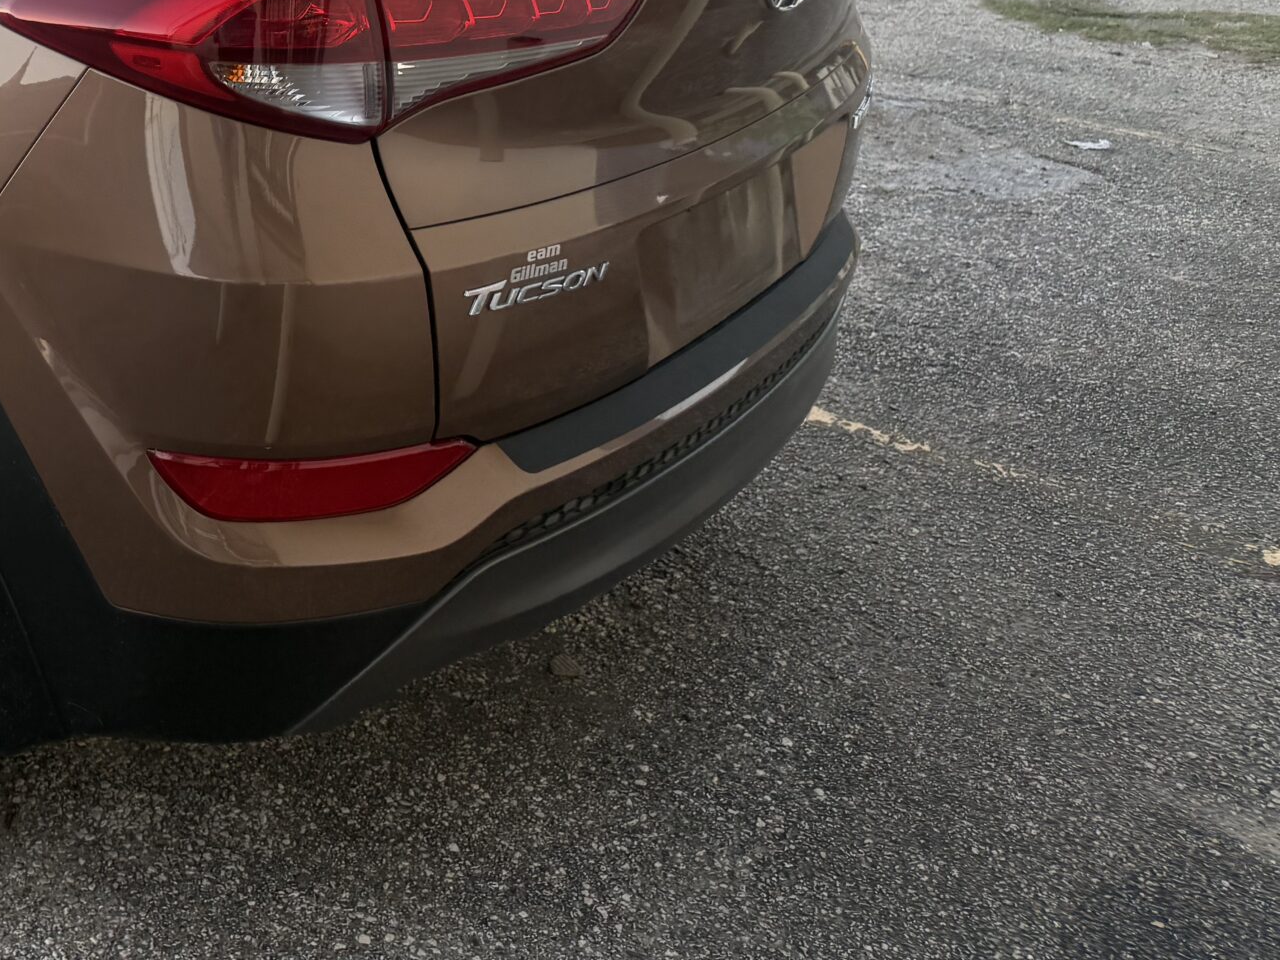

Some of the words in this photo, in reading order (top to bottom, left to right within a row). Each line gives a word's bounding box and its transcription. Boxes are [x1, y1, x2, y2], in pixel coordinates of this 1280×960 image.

[527, 243, 561, 262] eam
[510, 258, 569, 283] Gillman
[463, 260, 610, 317] TUCSON
